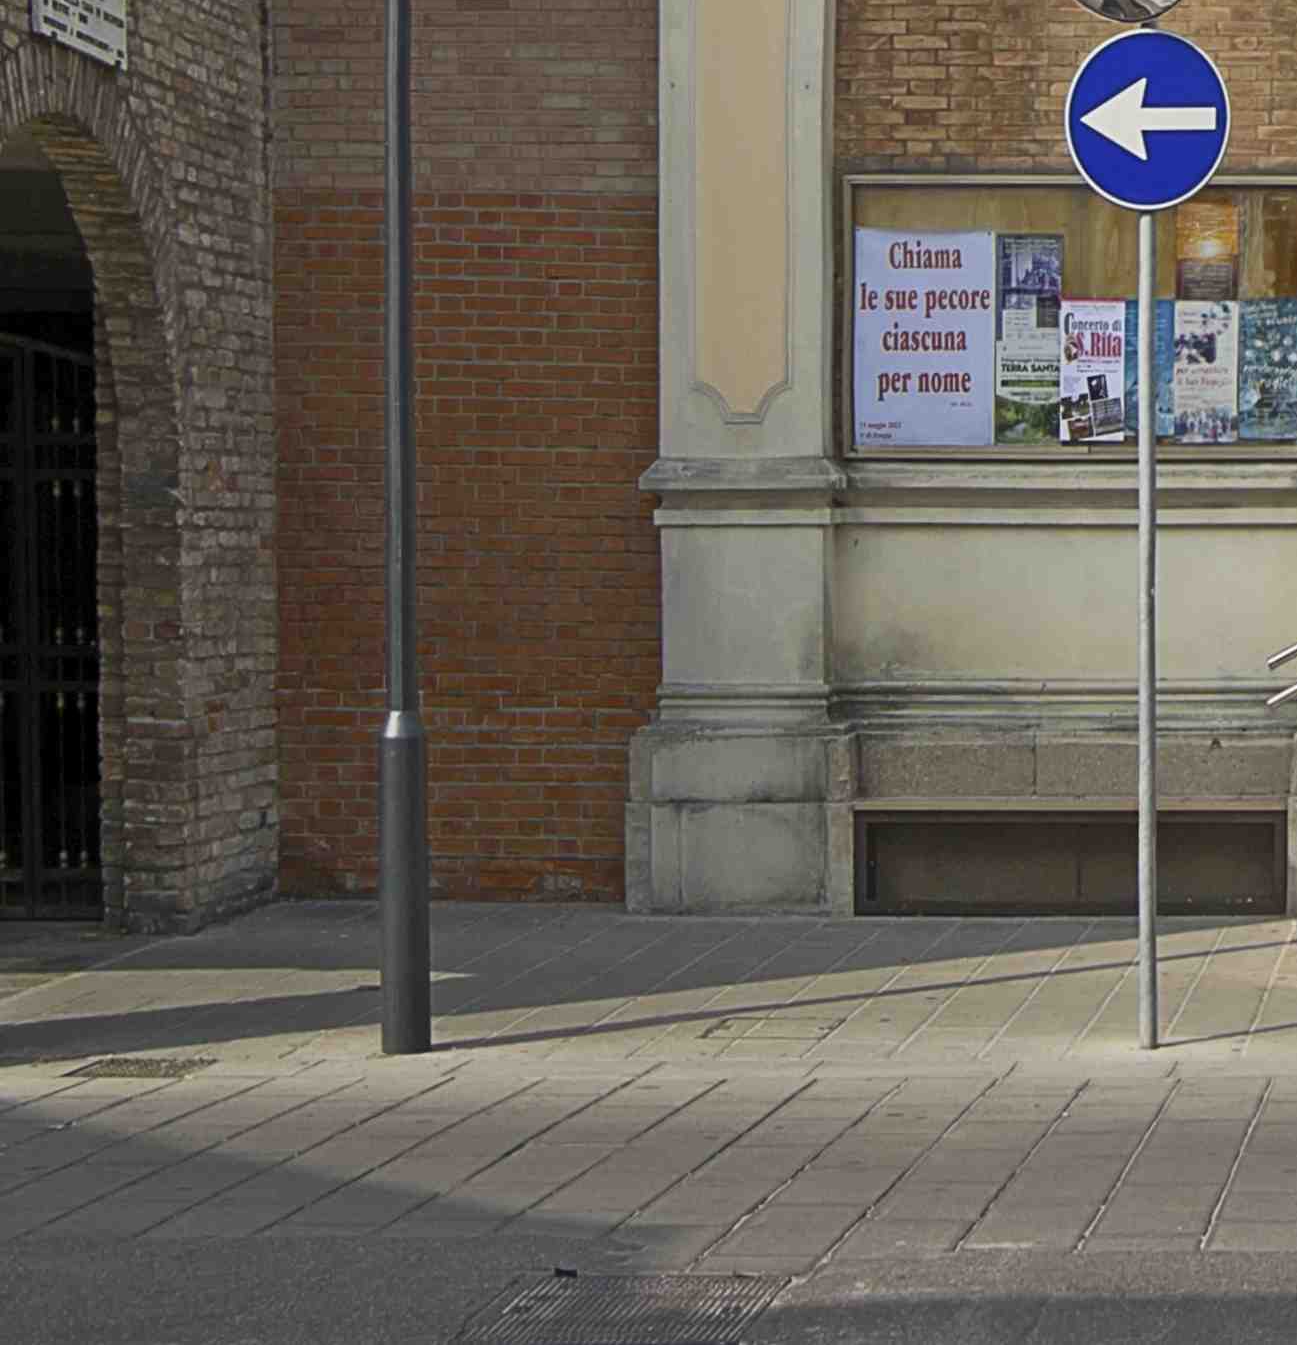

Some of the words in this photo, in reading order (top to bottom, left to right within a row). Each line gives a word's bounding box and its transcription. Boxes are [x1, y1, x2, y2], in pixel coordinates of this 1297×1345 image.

[888, 240, 962, 270] Chiama
[860, 282, 878, 311] le
[884, 287, 919, 311] sue
[925, 285, 991, 318] pecore
[882, 322, 967, 352] ciascuna
[1064, 312, 1110, 336] Concerto
[1001, 364, 1029, 373] TERRA
[1031, 364, 1059, 373] SANTA
[877, 372, 912, 401] per
[917, 372, 971, 393] nome
